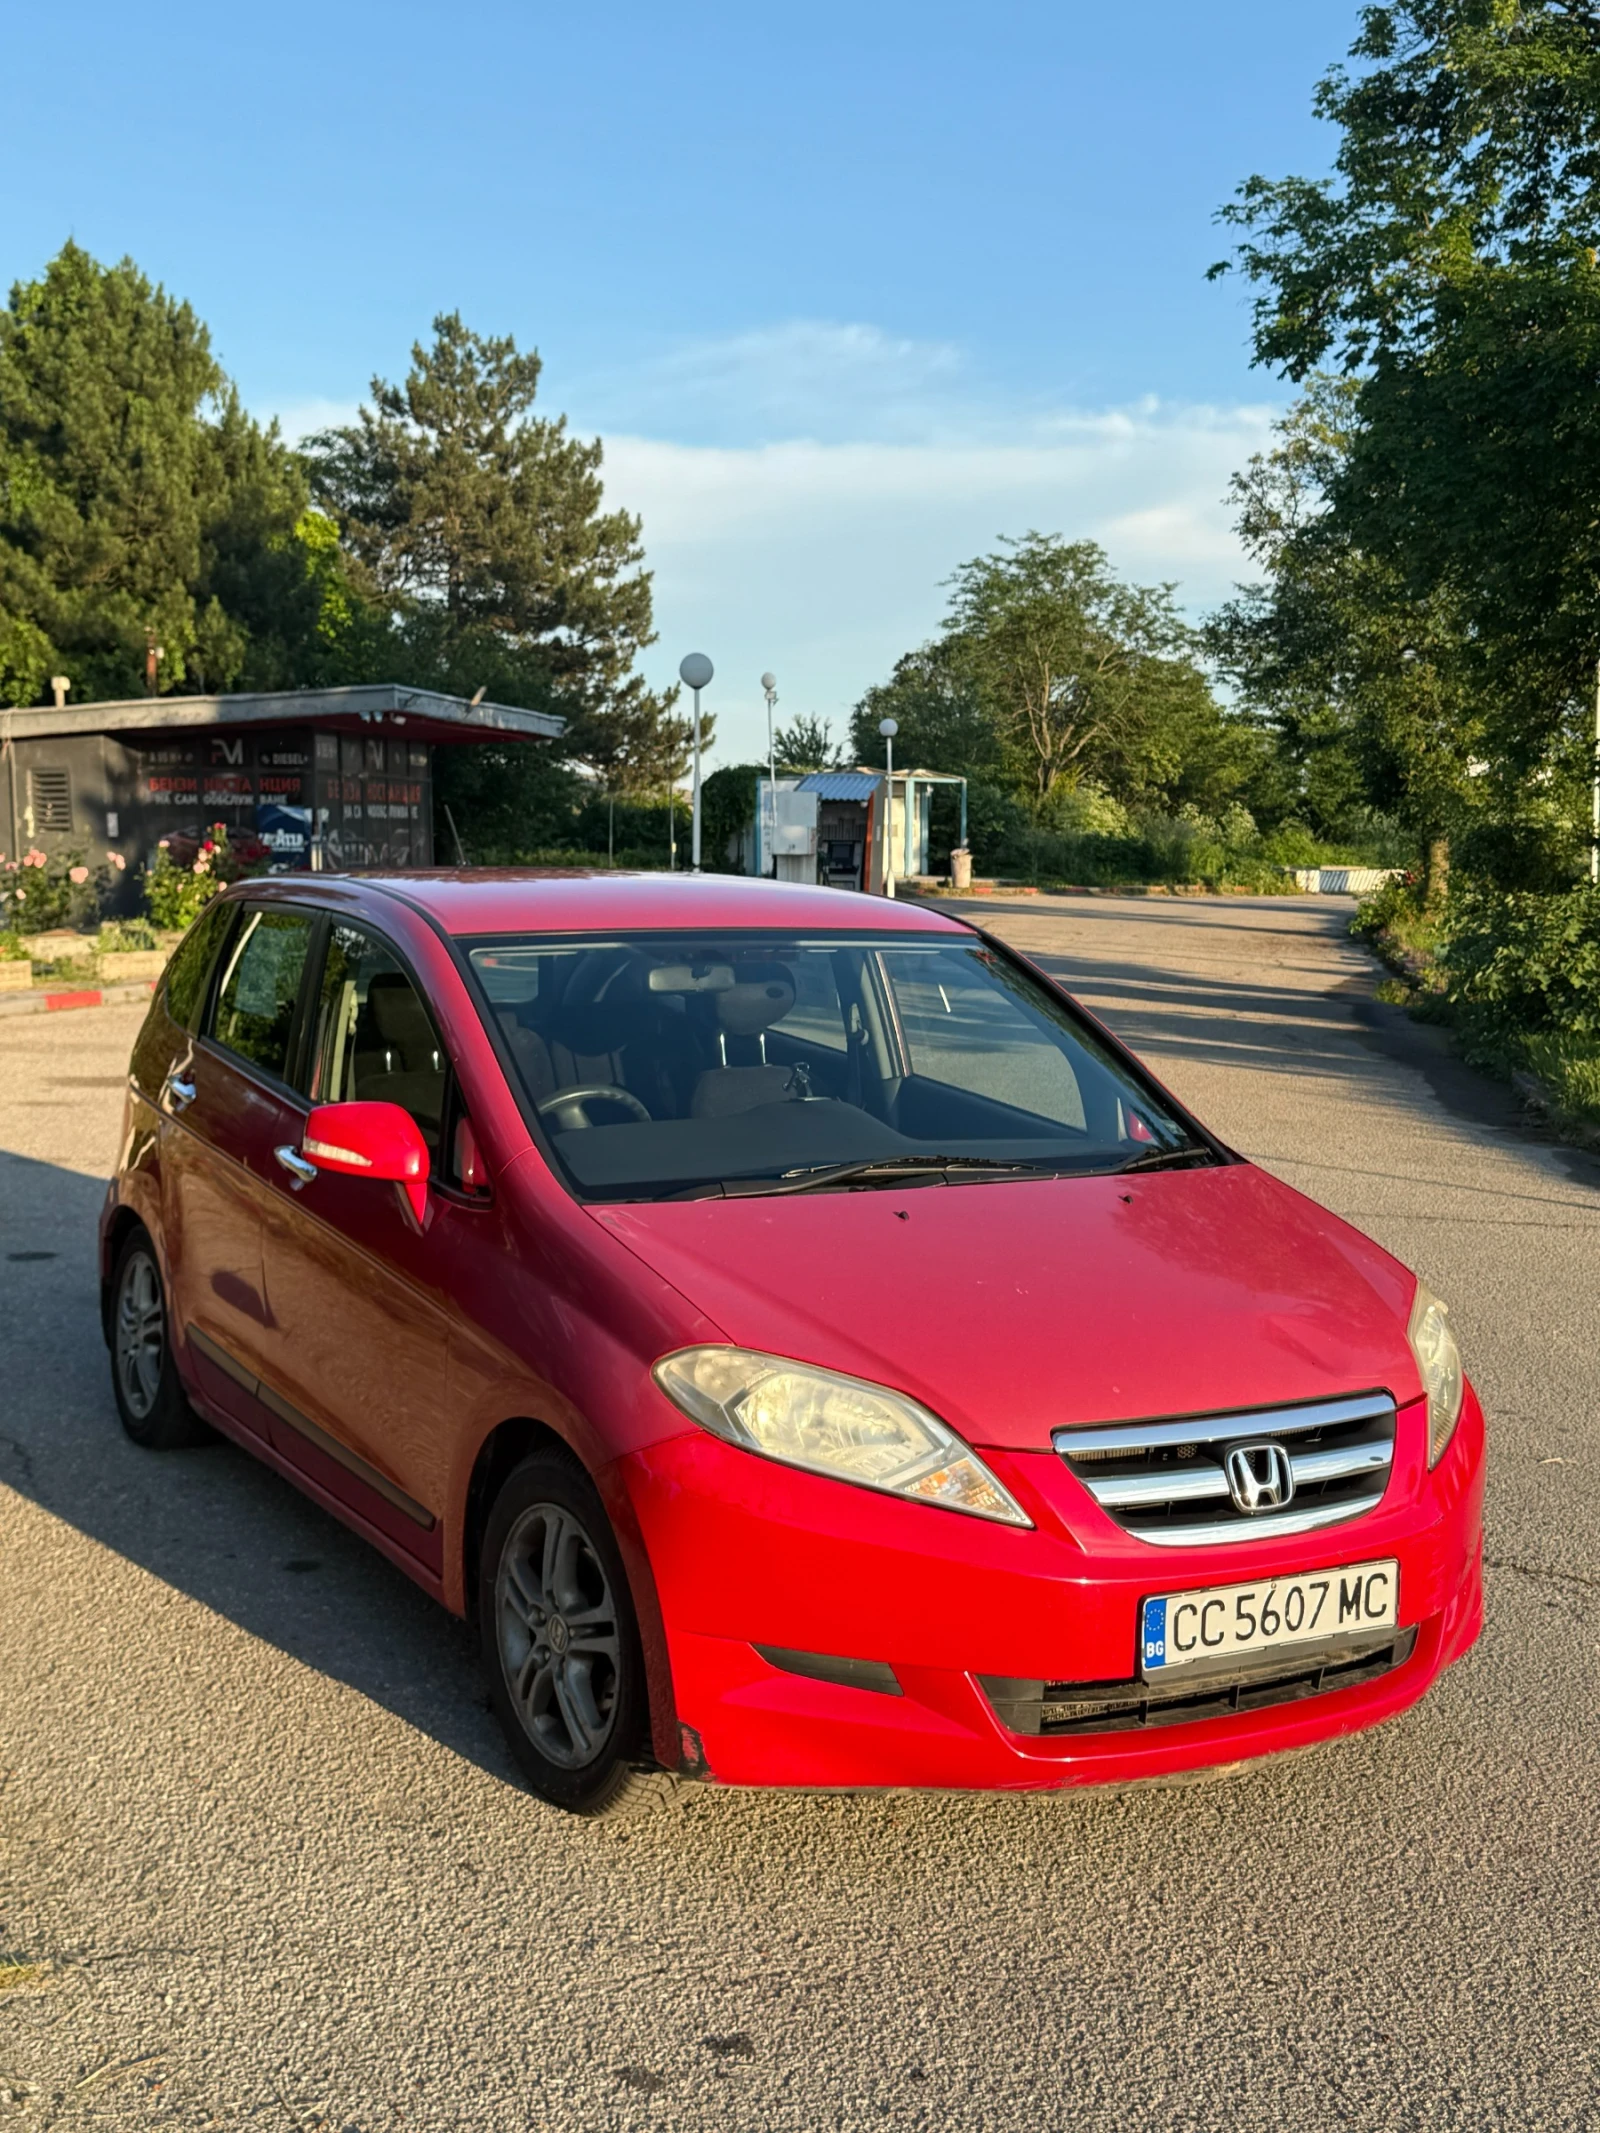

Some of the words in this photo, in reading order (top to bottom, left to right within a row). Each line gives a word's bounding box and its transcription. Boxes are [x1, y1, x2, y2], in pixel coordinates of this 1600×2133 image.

[1173, 1600, 1225, 1651] CC
[1235, 1581, 1330, 1641] 5607
[1338, 1573, 1388, 1624] MC
[1146, 1642, 1164, 1658] BG
